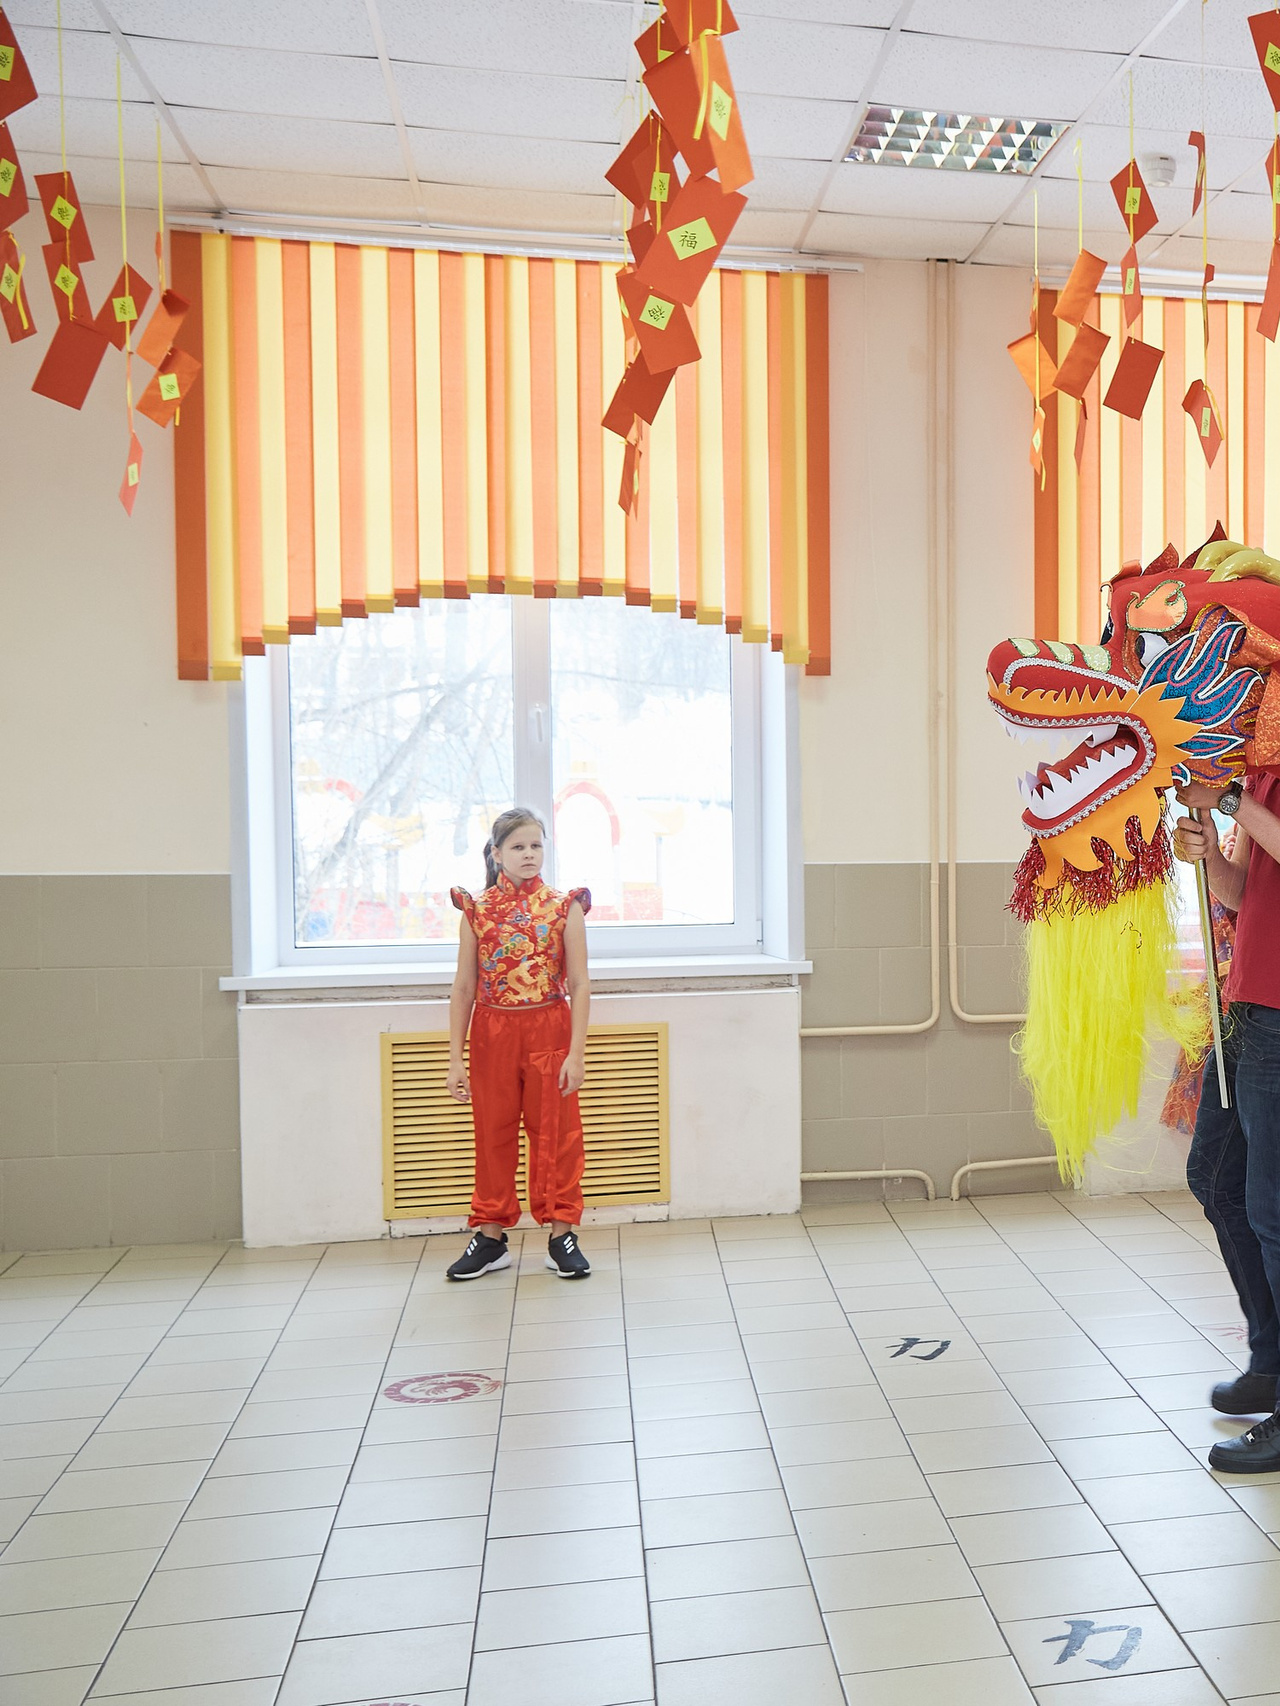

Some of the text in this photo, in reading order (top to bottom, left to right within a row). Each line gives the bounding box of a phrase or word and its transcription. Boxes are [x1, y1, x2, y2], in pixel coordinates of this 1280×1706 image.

[679, 230, 698, 250] 福
[648, 304, 667, 322] 福
[885, 1337, 951, 1361] 力
[1042, 1620, 1142, 1671] 力
